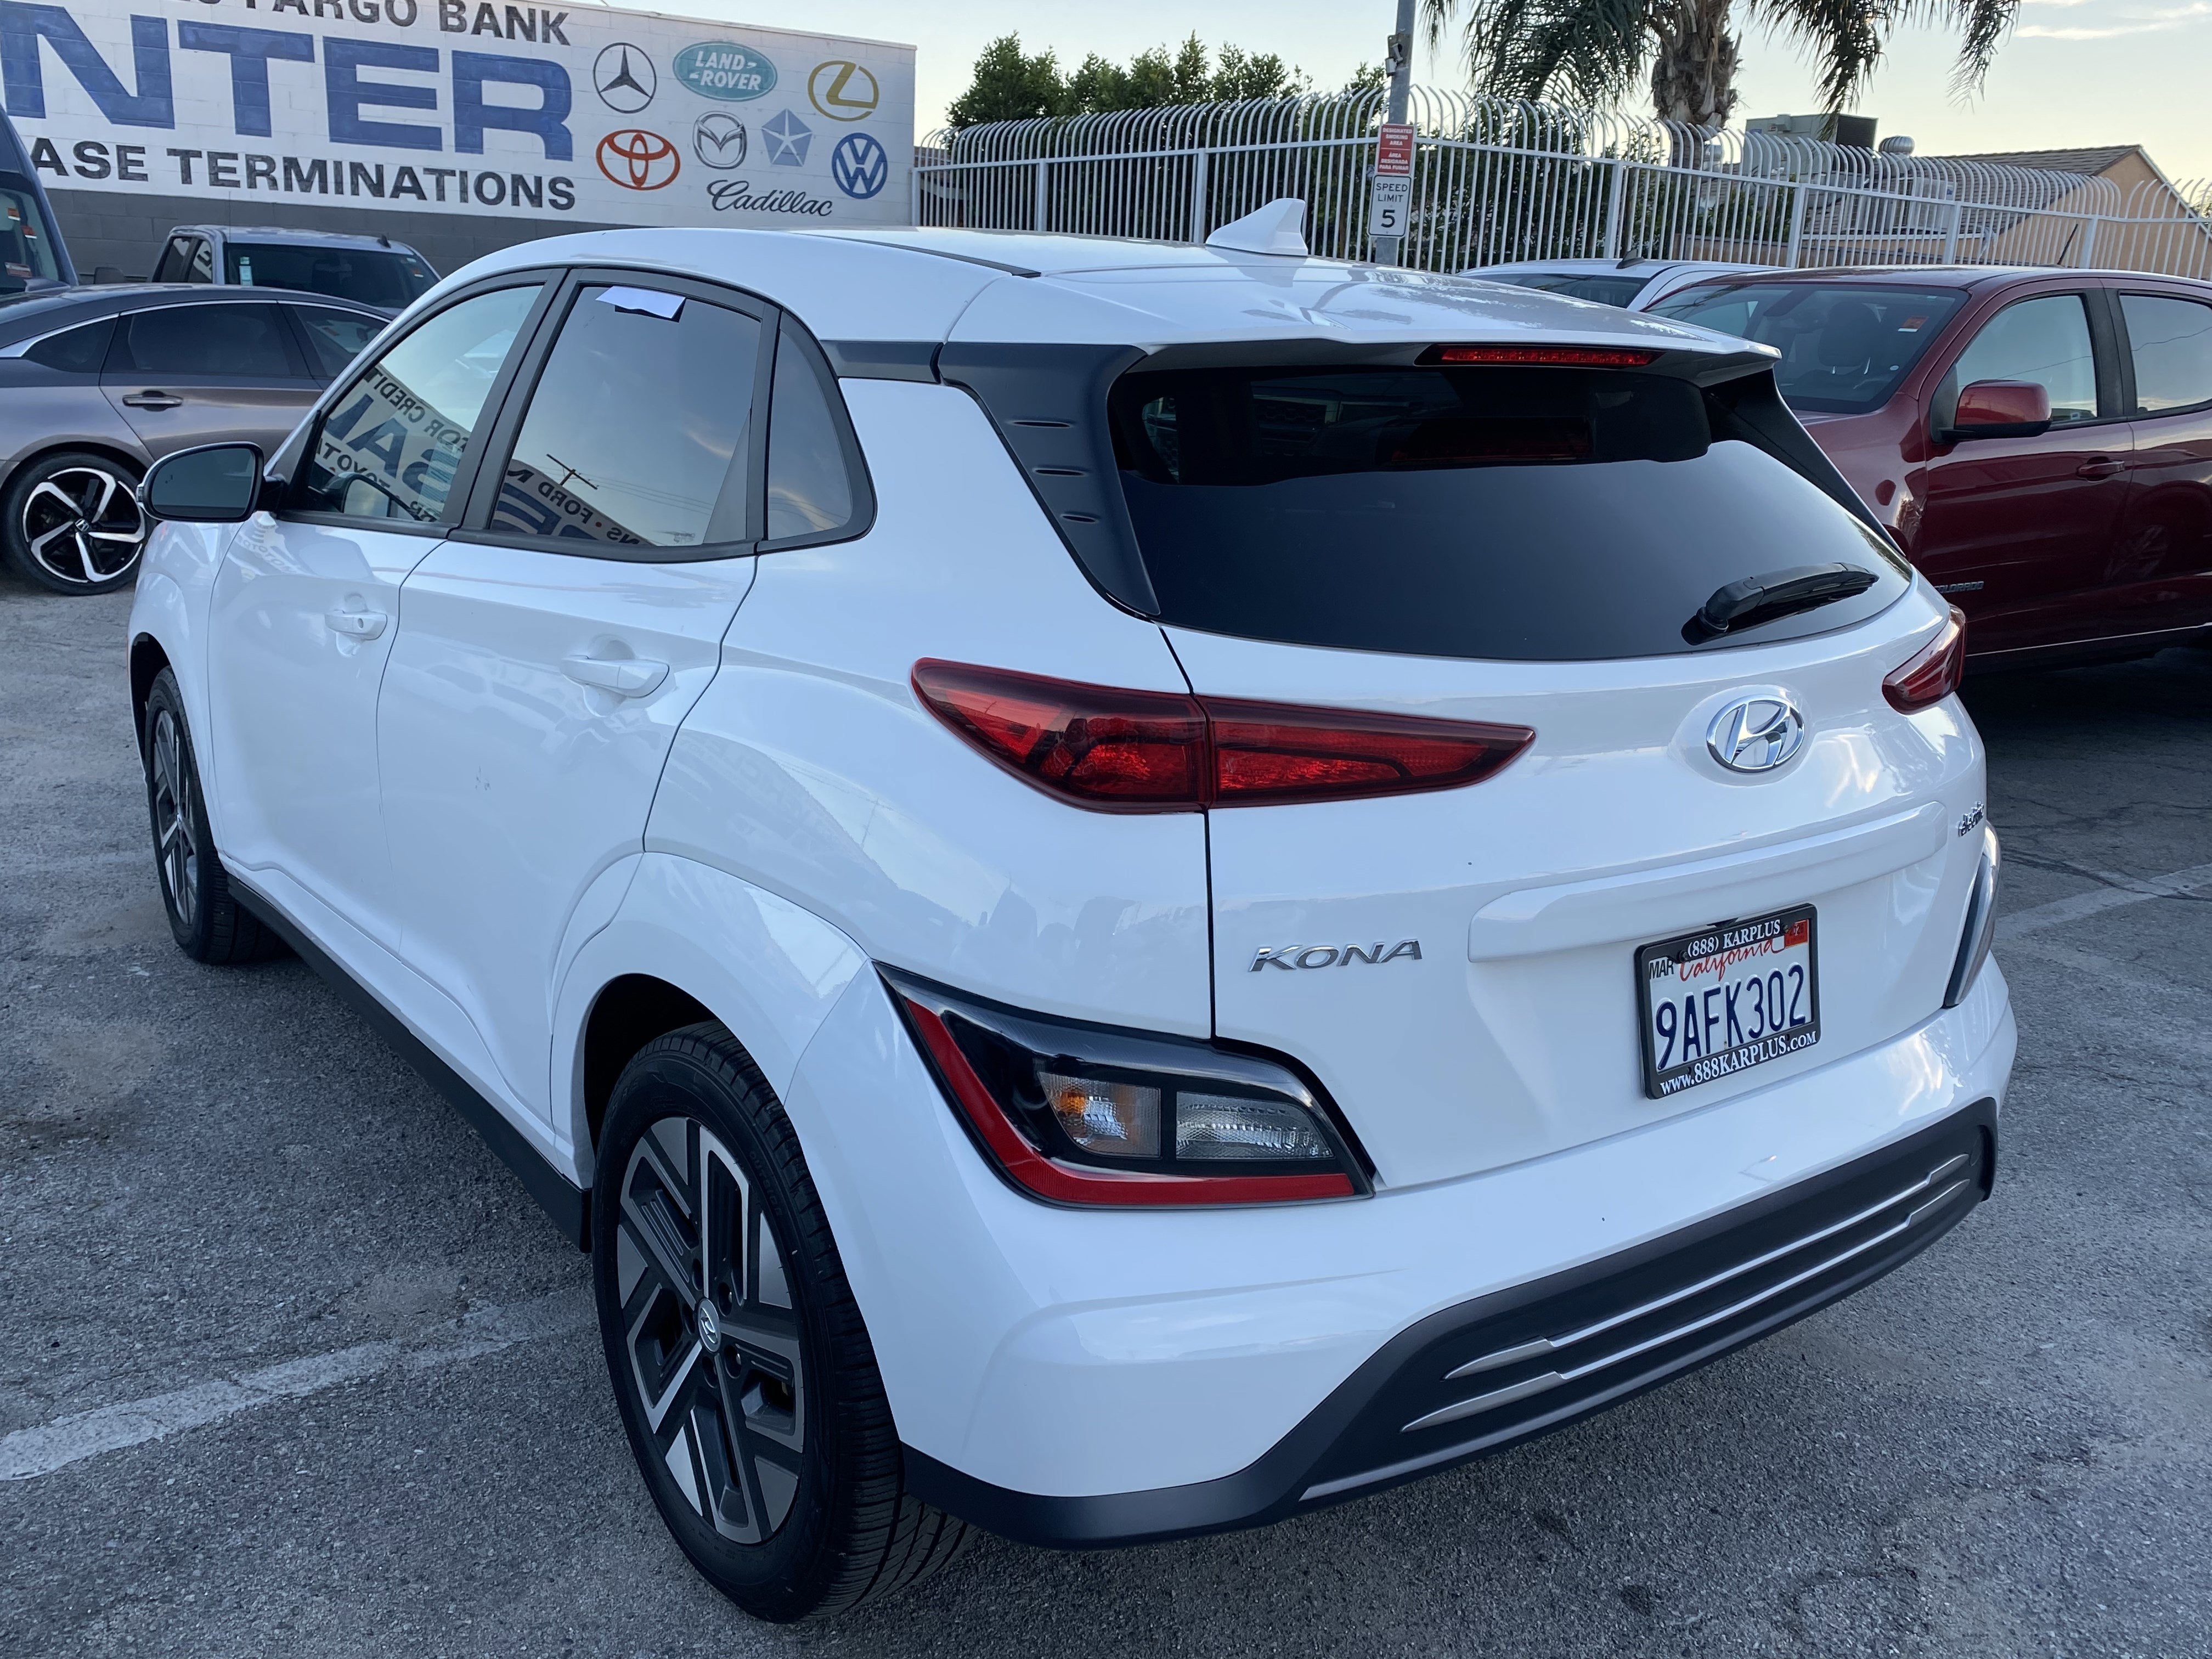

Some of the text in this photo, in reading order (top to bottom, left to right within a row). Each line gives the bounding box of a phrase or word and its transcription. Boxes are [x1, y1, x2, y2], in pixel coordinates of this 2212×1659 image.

[246, 0, 571, 46] RGO BANK
[695, 50, 746, 70] LAND
[0, 1, 573, 161] NTER
[699, 72, 761, 91] ROVER
[167, 148, 575, 210] TERMINATIONS
[706, 179, 833, 216] Cadillac
[1375, 183, 1408, 192] SPEED
[1378, 194, 1403, 203] LIMIT
[1380, 209, 1396, 228] 5
[1248, 939, 1423, 973] KONA
[1687, 936, 1719, 957] (888)
[1723, 919, 1781, 950] KARPLUS
[1649, 939, 1785, 982] MAR California
[1656, 963, 1806, 1070] 9AFK302
